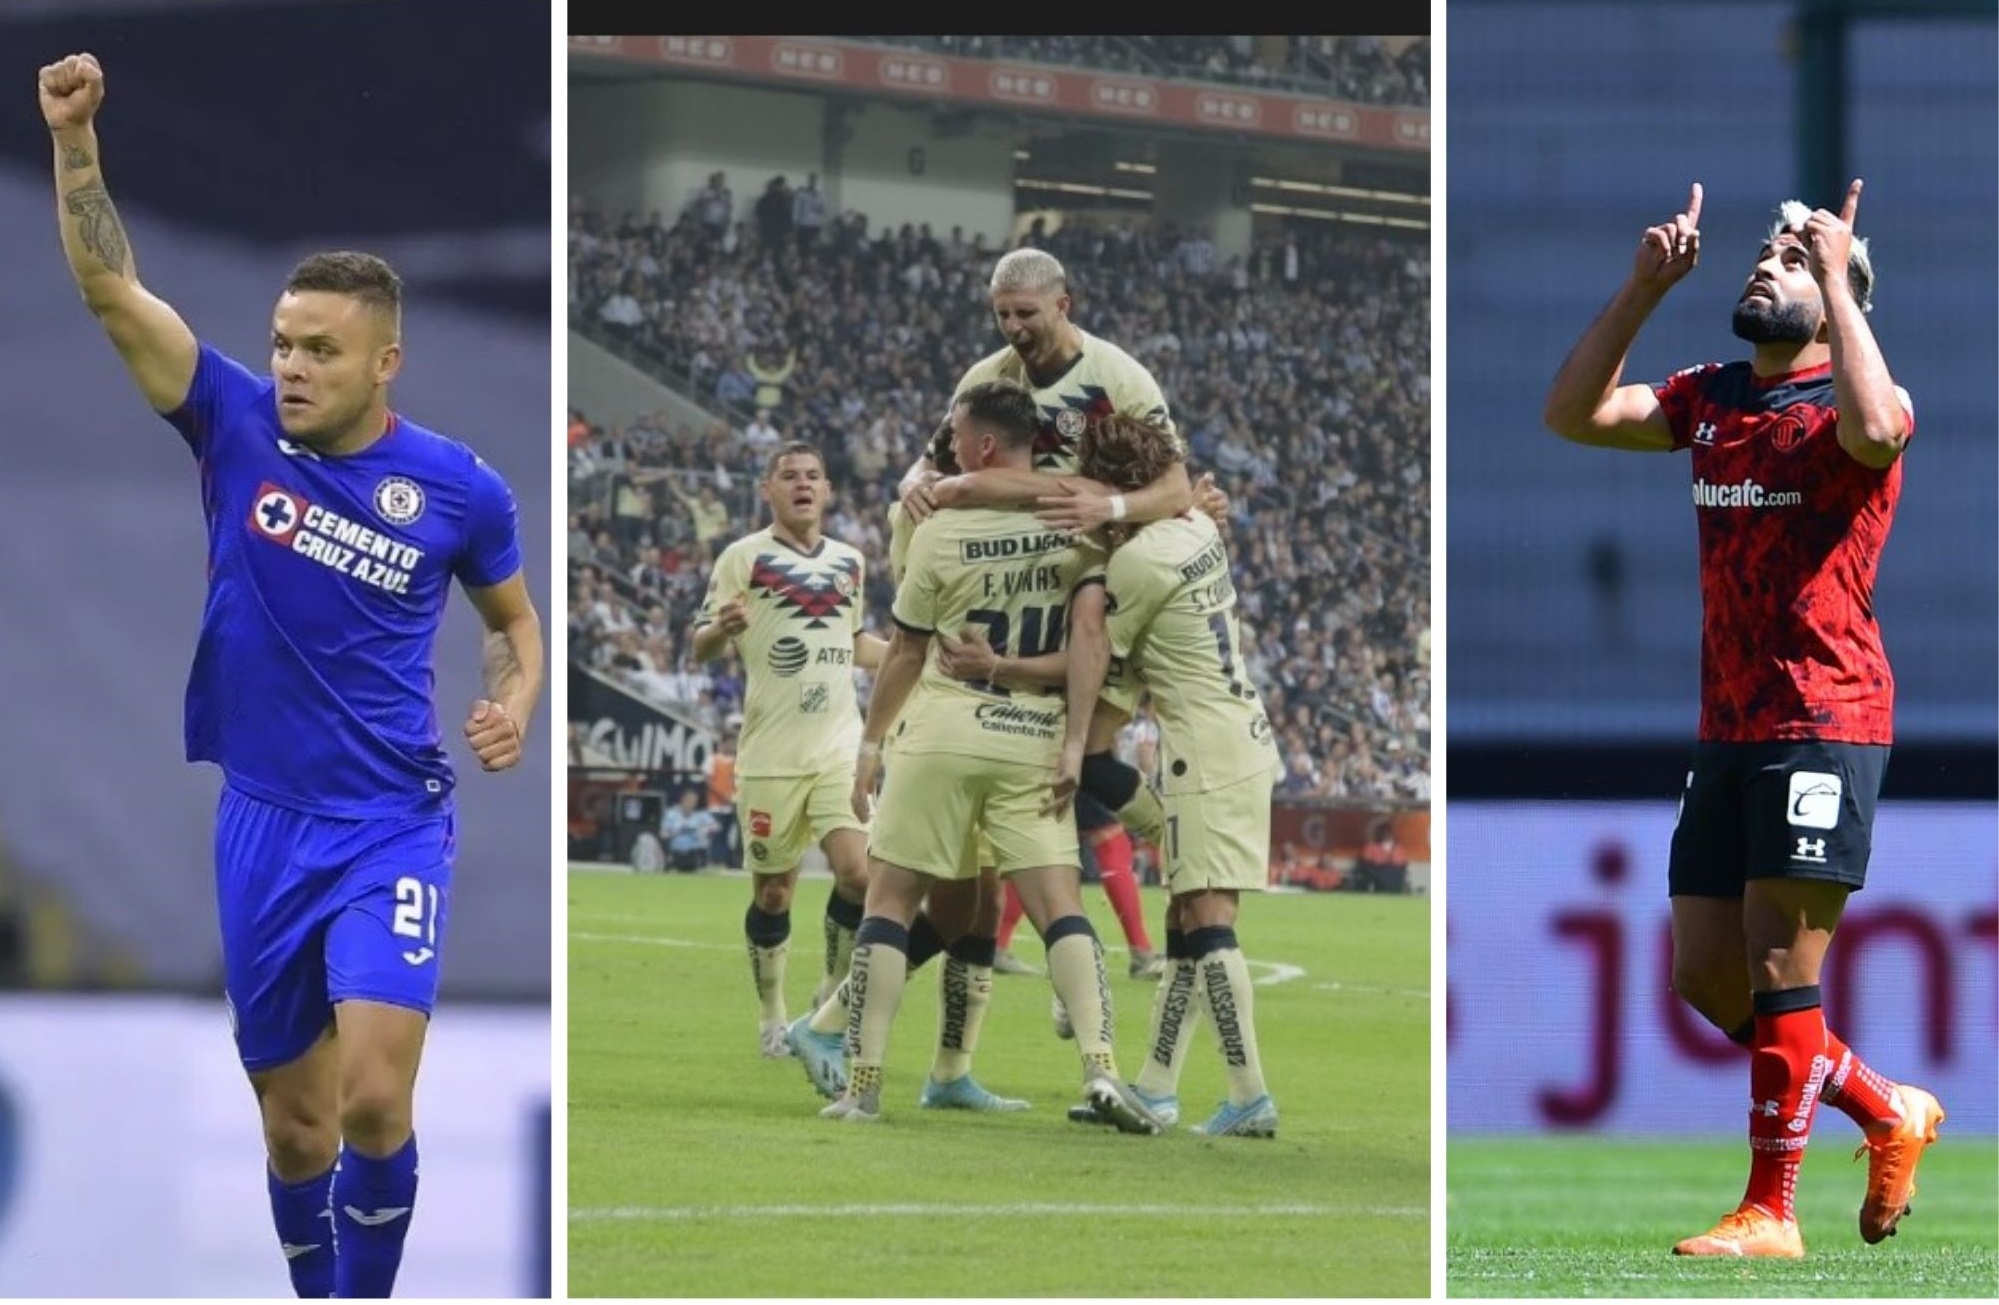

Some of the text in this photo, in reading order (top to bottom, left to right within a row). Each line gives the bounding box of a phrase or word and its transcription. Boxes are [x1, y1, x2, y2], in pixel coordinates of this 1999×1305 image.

[303, 504, 419, 570] CEMENTO
[966, 539, 1018, 559] BUD
[292, 530, 411, 594] CRUZ AZUL
[1180, 551, 1213, 581] BUD
[984, 573, 996, 597] F.
[815, 647, 853, 665] AT&T
[393, 877, 438, 946] 21
